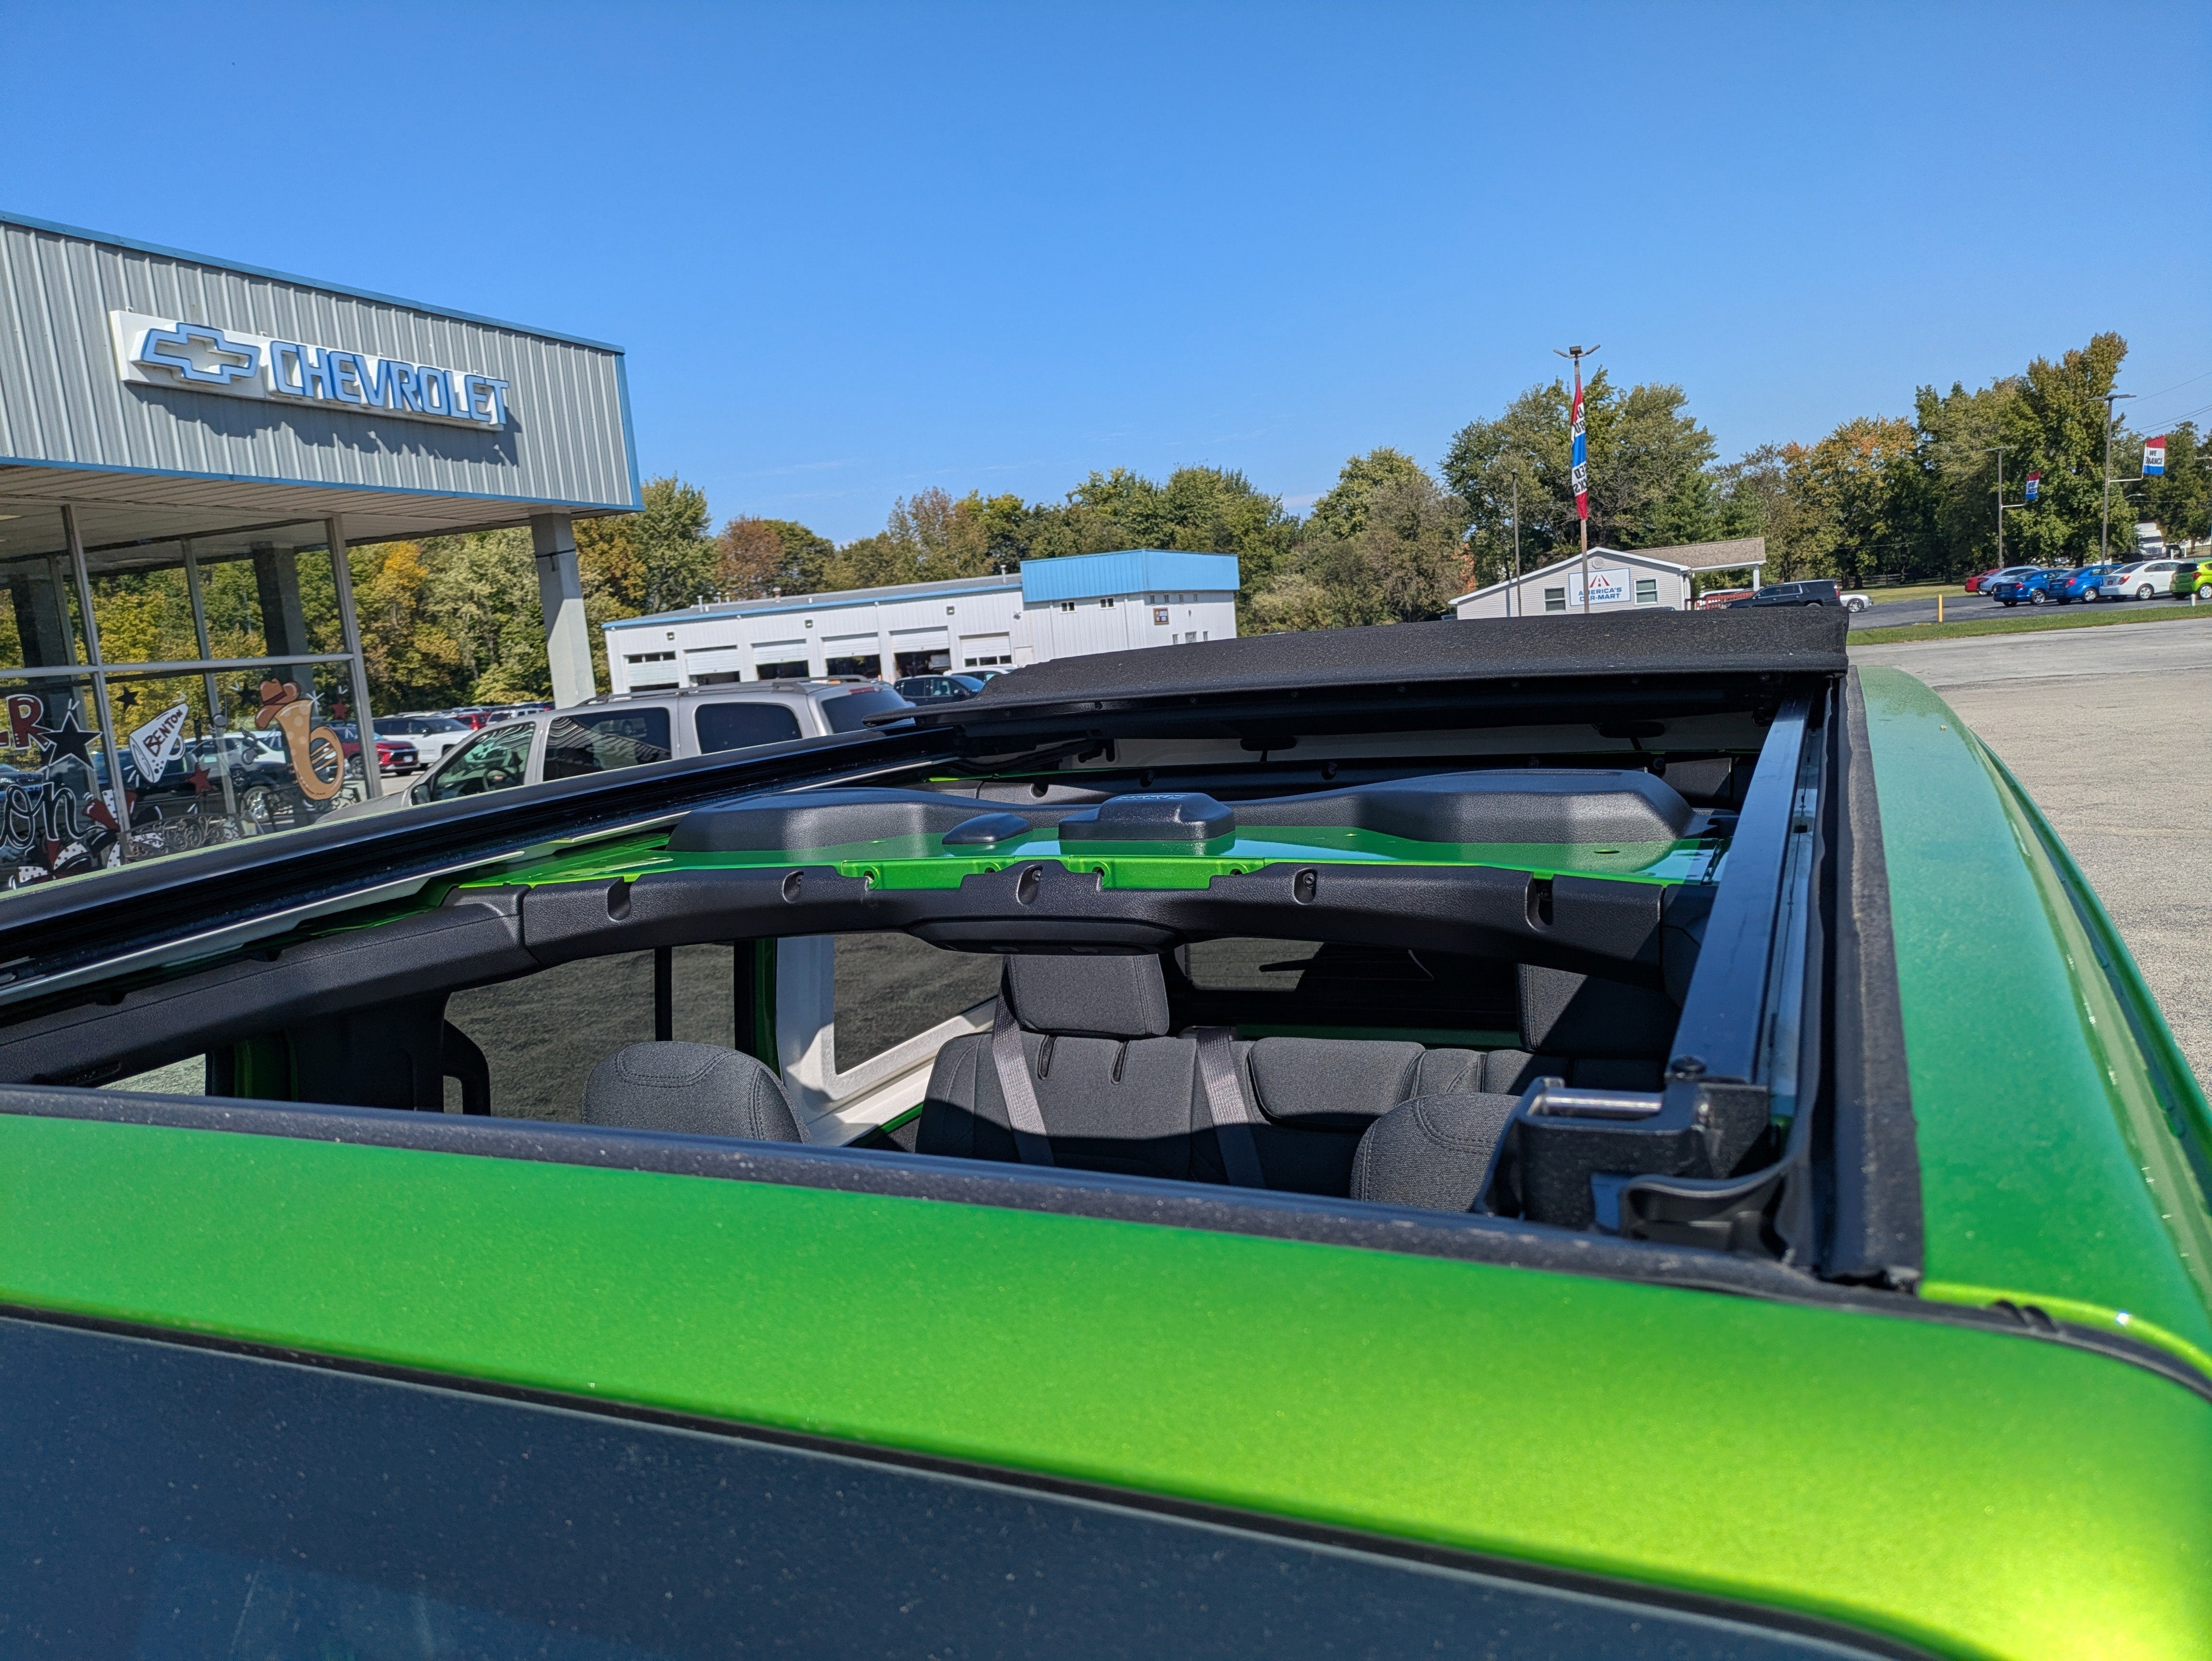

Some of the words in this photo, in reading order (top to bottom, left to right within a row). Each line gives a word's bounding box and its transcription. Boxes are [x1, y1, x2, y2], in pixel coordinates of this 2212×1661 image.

[270, 340, 509, 424] CHEVROLET
[1578, 587, 1622, 596] AERICA'S
[1579, 593, 1620, 601] CR-MART
[143, 709, 183, 757] BENTON
